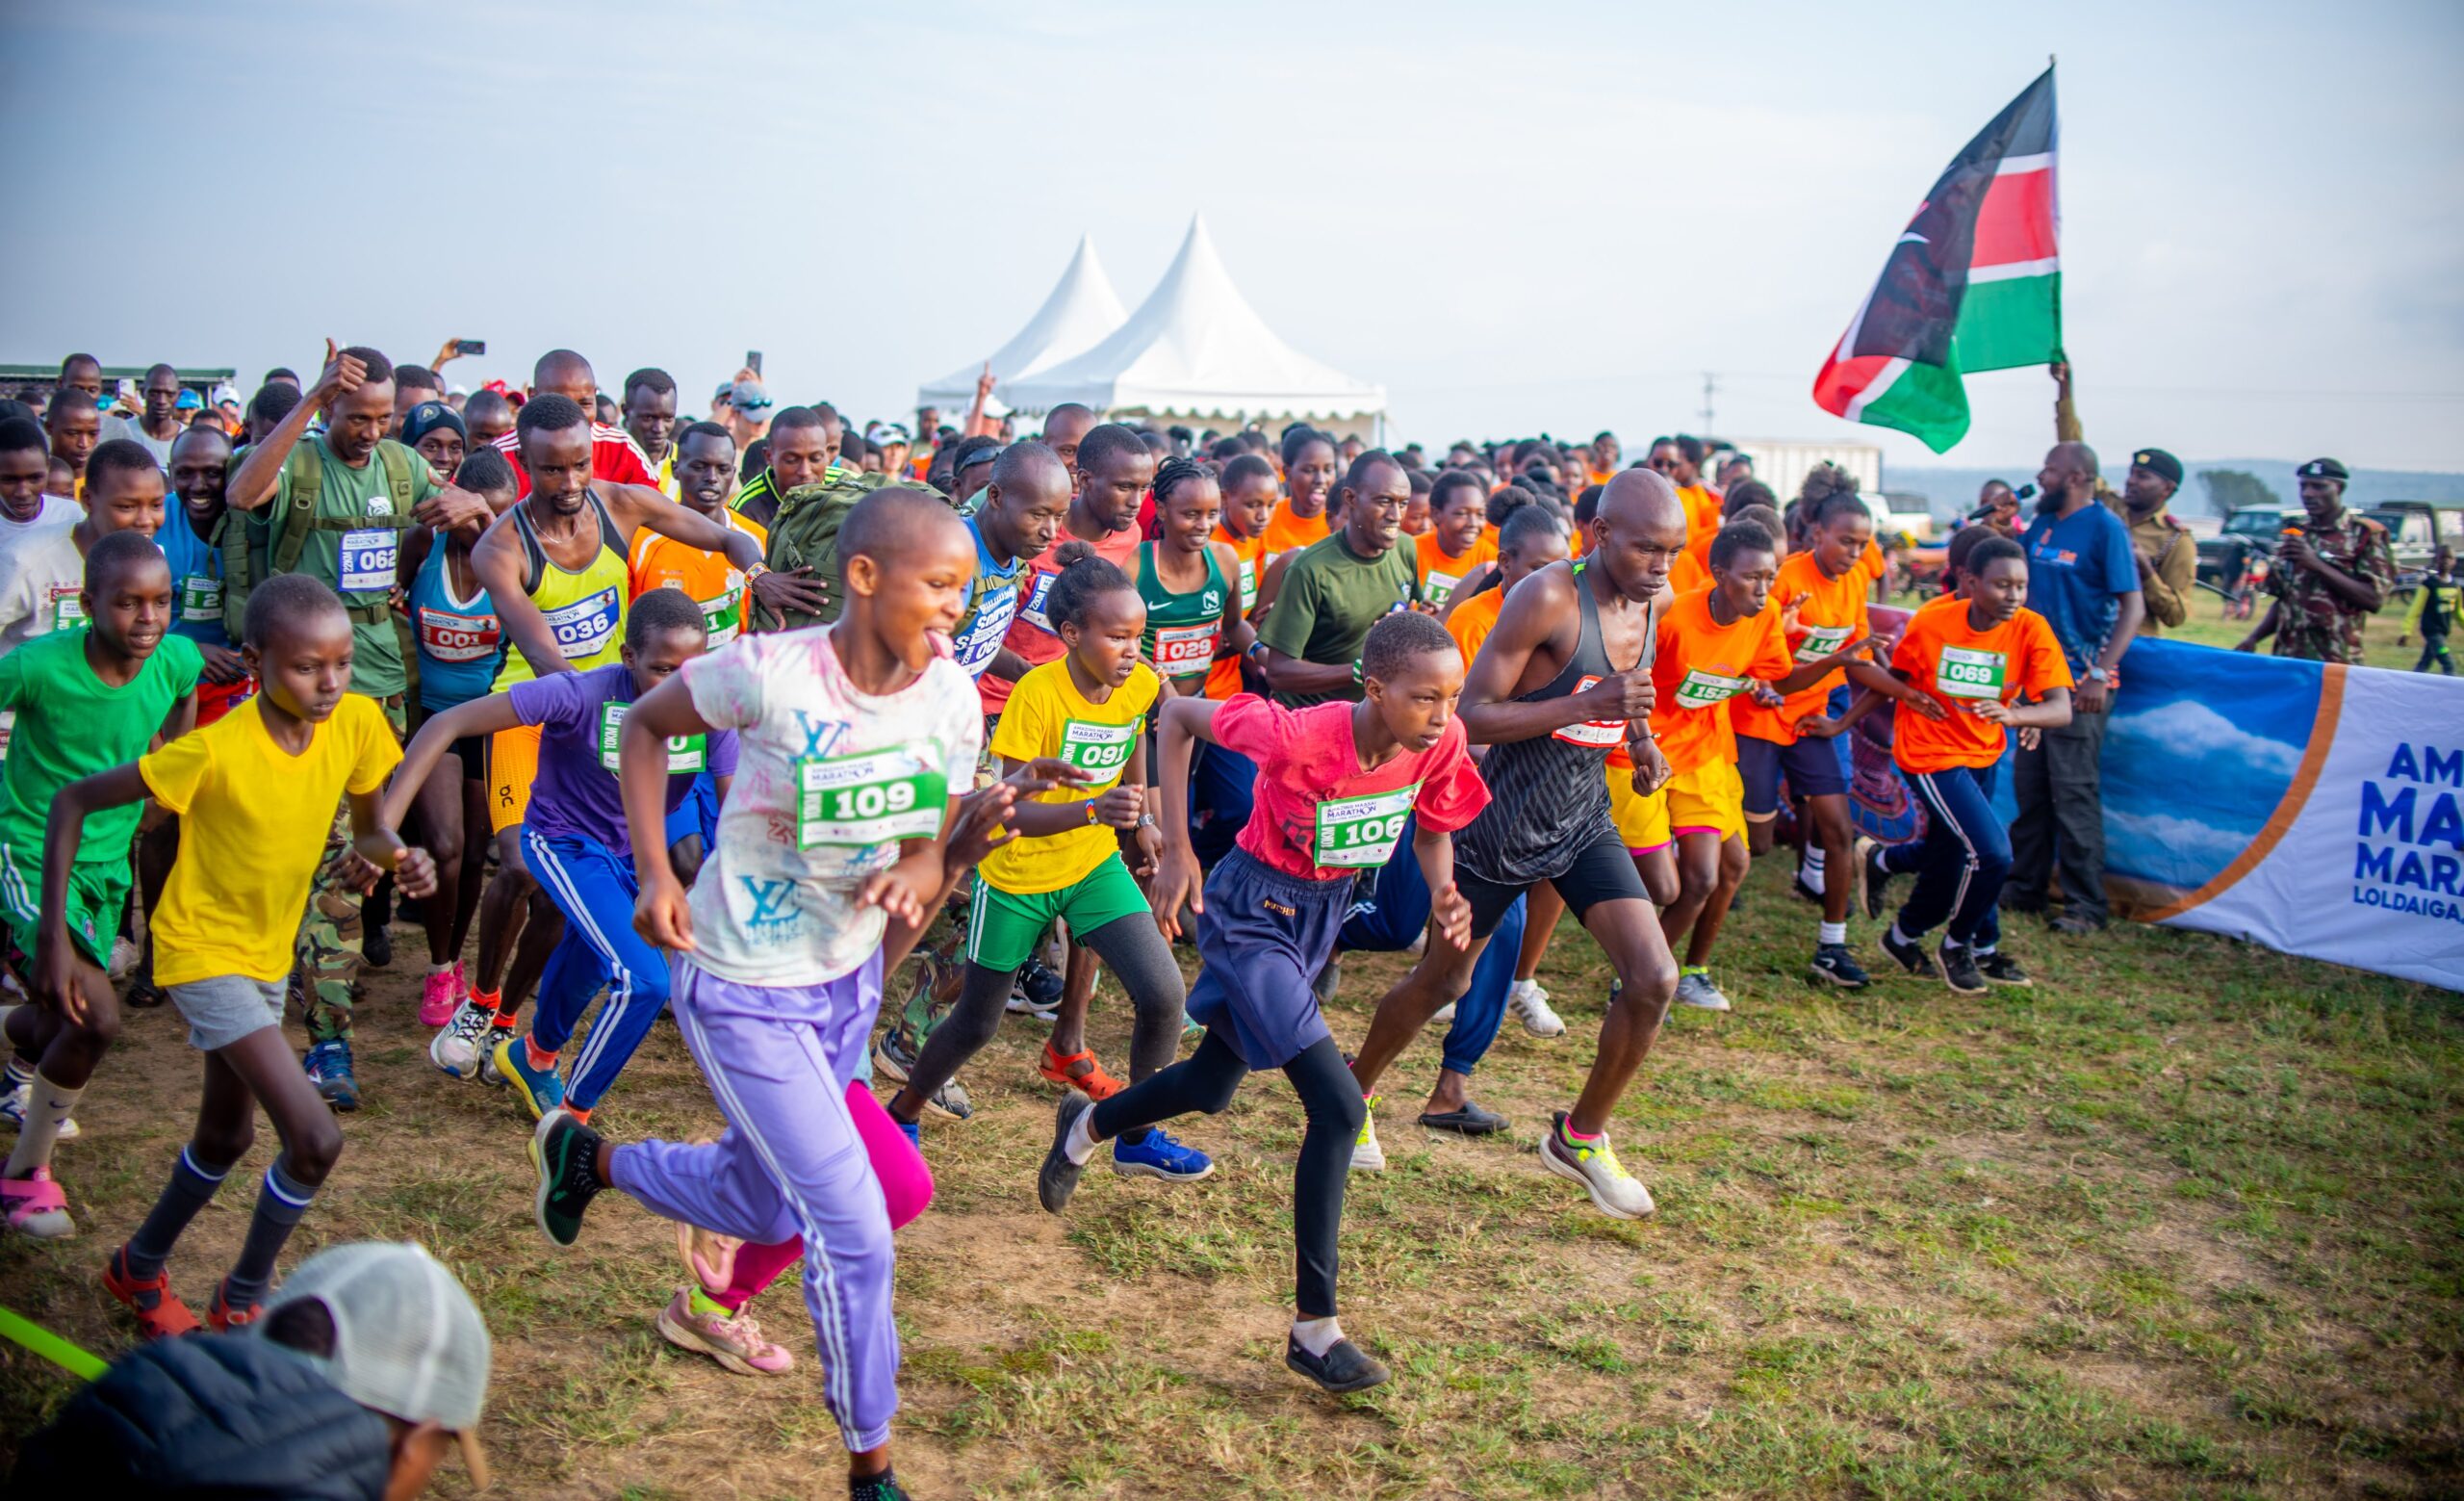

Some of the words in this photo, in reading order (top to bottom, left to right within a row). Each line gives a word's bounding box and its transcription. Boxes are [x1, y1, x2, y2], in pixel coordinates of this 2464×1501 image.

[360, 549, 398, 571] 062
[558, 612, 609, 643] 036
[437, 630, 479, 648] 001
[1169, 638, 1212, 660] 029
[1950, 663, 1992, 684] 069
[1694, 686, 1732, 700] 152
[604, 727, 618, 749] 10KM
[1082, 743, 1127, 765] 091
[835, 782, 916, 818] 109
[1327, 805, 1376, 818] MARATHON
[1345, 815, 1405, 845] 106
[2354, 841, 2464, 897] MAR
